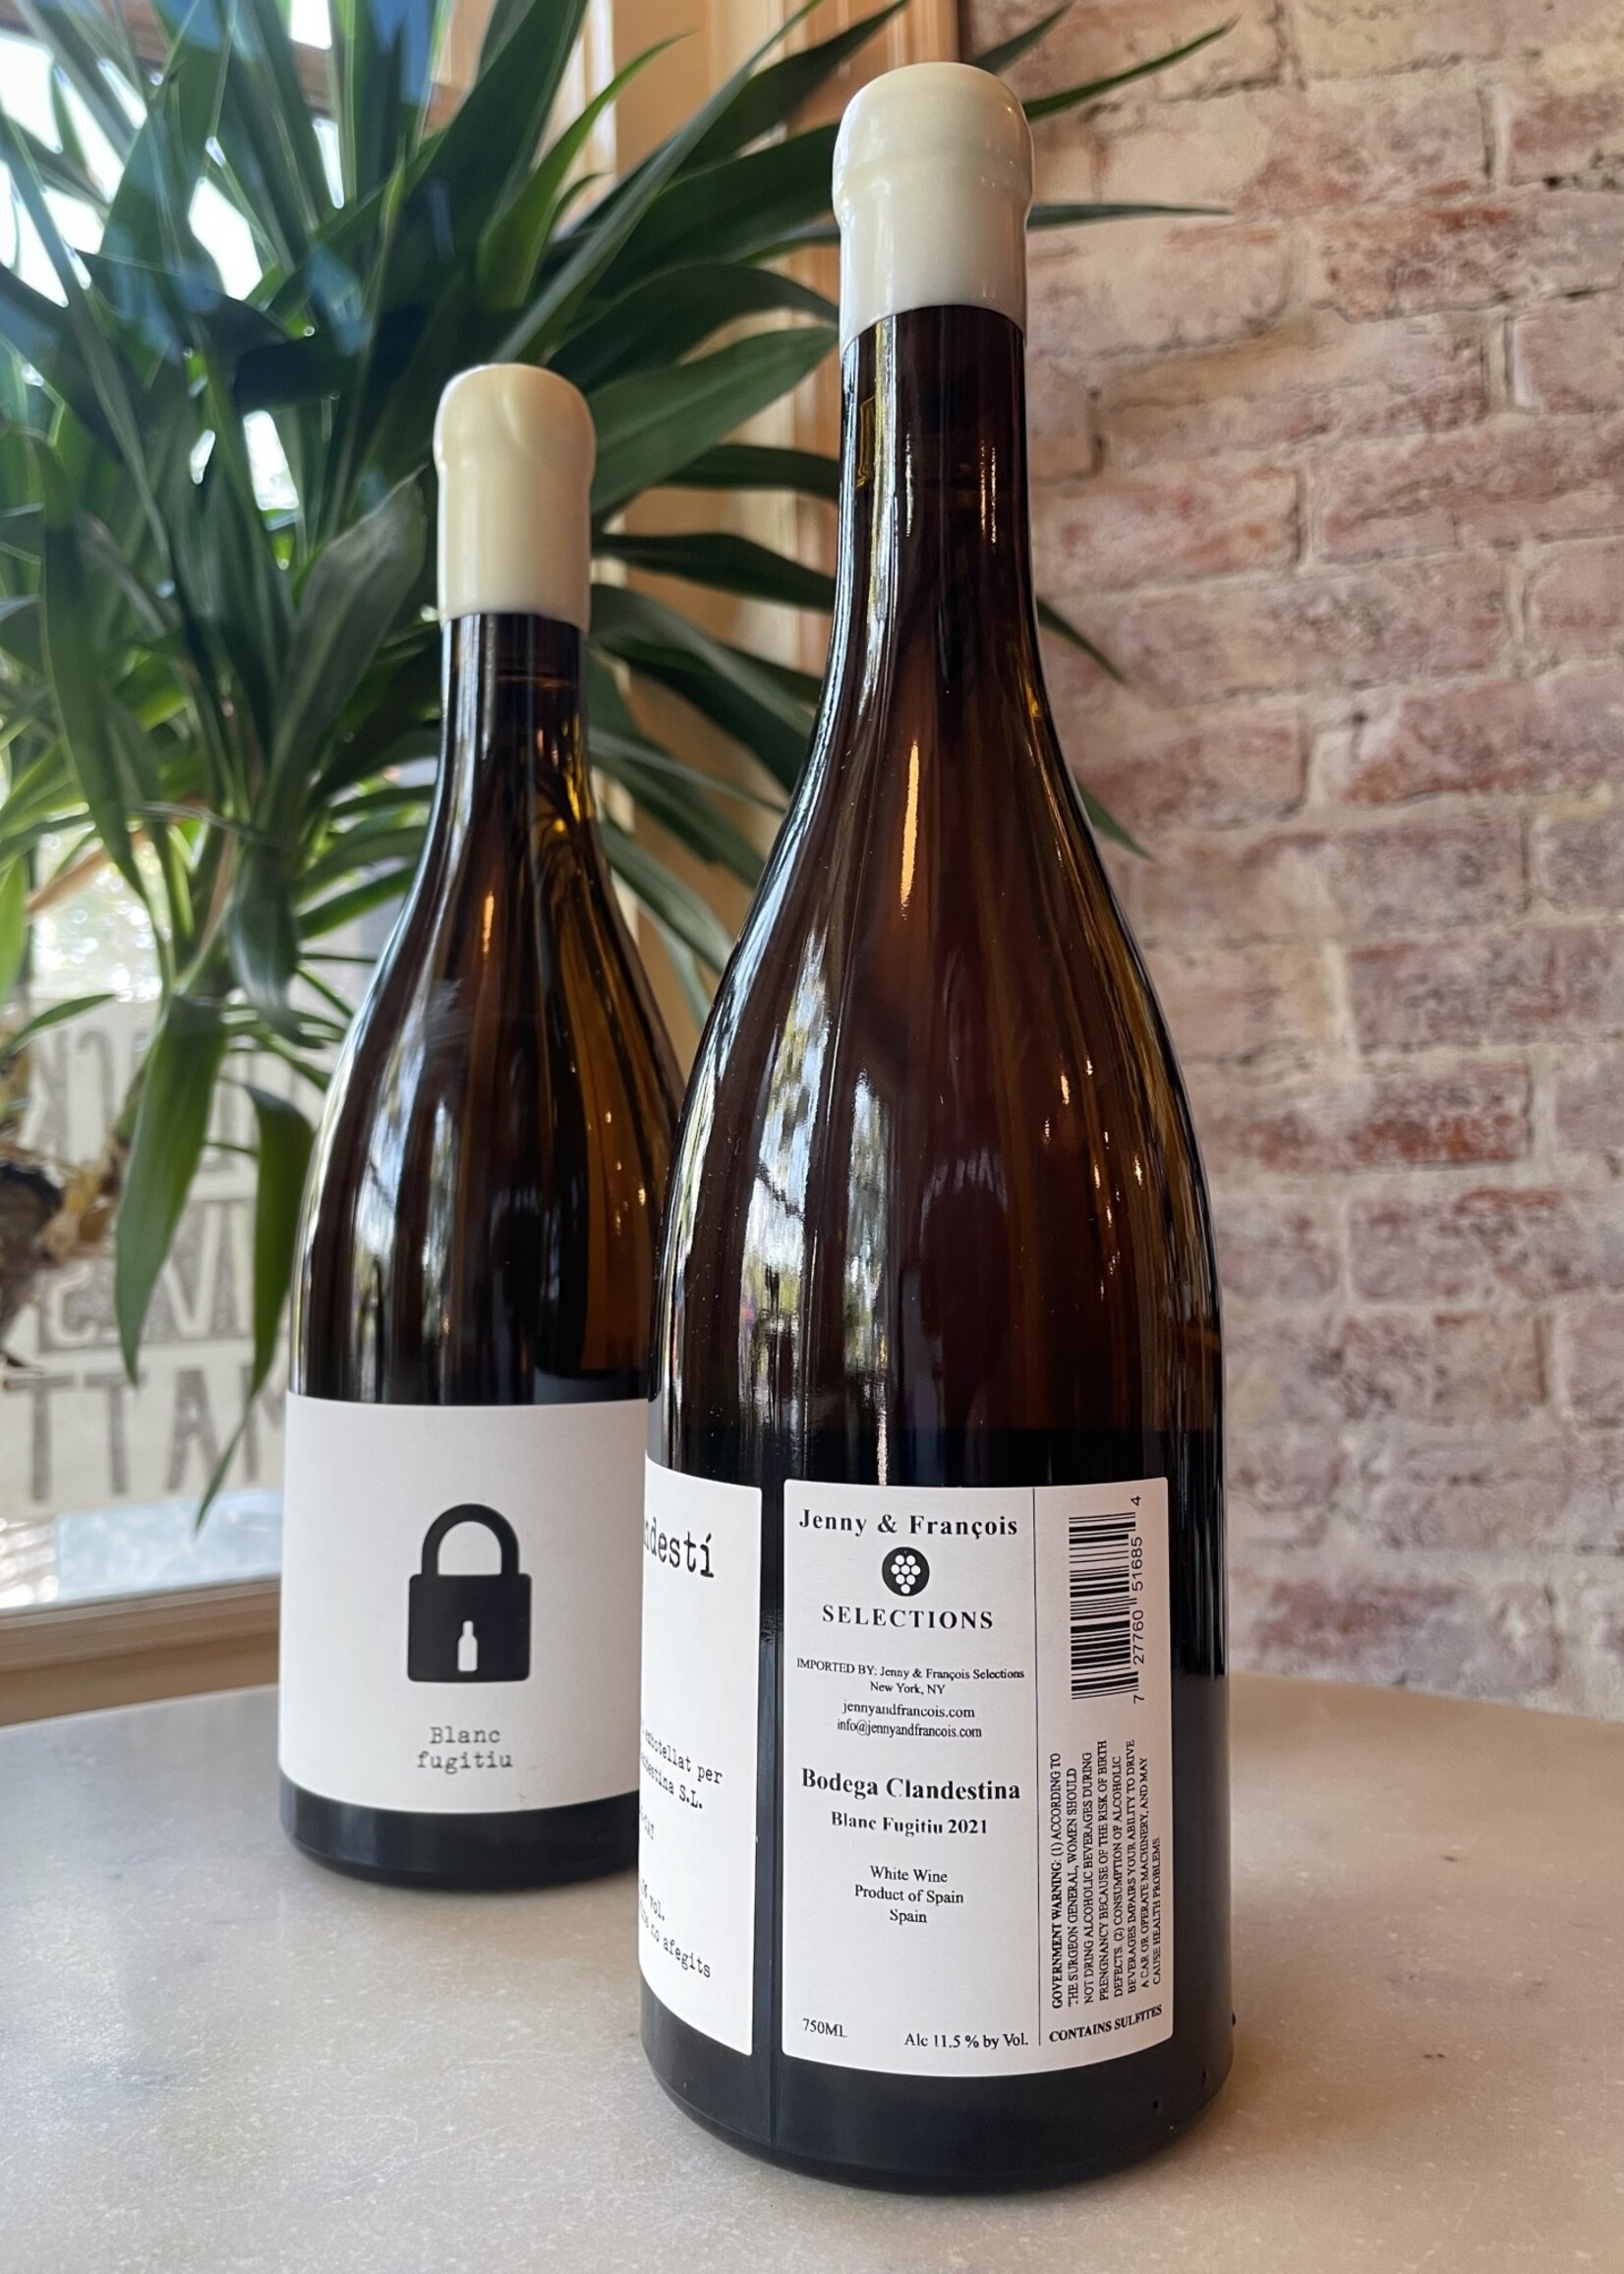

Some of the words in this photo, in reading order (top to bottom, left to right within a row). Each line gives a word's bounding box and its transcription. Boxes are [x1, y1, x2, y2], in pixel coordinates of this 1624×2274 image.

[1131, 1494, 1141, 1506] 4
[799, 1509, 867, 1537] Jenny
[877, 1514, 898, 1534] &
[909, 1515, 1017, 1540] François
[1131, 1536, 1143, 1591] 51685
[822, 1604, 993, 1630] SELECTIONS
[1132, 1610, 1144, 1664] 27760
[796, 1658, 855, 1674] IMPORTED
[858, 1663, 877, 1677] BY:
[880, 1666, 910, 1680] Jenny
[912, 1668, 922, 1679] &
[926, 1669, 970, 1681] François
[973, 1669, 1024, 1680] Selections
[870, 1681, 893, 1693] New
[896, 1683, 924, 1695] York,
[926, 1684, 946, 1695] NY
[1132, 1695, 1144, 1704] 7
[842, 1701, 975, 1720] jennyandfrancois.com
[430, 1726, 501, 1744] Blanc
[837, 1720, 982, 1738] info@jennyandfrancois.com
[417, 1750, 513, 1775] fugitiu
[1050, 1753, 1062, 1769] TO
[1097, 1740, 1107, 1776] BIRTH
[1139, 1757, 1148, 1783] MAY
[697, 1765, 723, 1784] per
[801, 1768, 878, 1800] Bodega
[886, 1778, 1020, 1800] Clandestina
[1082, 1752, 1092, 1799] DURING
[1098, 1778, 1107, 1793] OF
[1127, 1778, 1134, 1794] TO
[678, 1783, 703, 1809] S.L.
[1066, 1768, 1077, 1817] SHOULD
[1113, 1756, 1123, 1823] ALCOHOLIC
[1050, 1771, 1062, 1840] ACCORDING
[1098, 1793, 1108, 1822] RISK
[1127, 1796, 1135, 1840] ABILITY
[832, 1811, 876, 1831] Blanc
[883, 1817, 943, 1837] Fugitiu
[948, 1819, 988, 1835] 2021
[1083, 1800, 1093, 1870] BEVERAGES
[1099, 1823, 1109, 1848] THE
[1113, 1825, 1123, 1840] OF
[1051, 1842, 1064, 1857] (1)
[1067, 1819, 1077, 1864] WOMEN
[1140, 1810, 1149, 1882] MACHINERY,
[1099, 1850, 1109, 1864] OF
[1128, 1842, 1136, 1876] YOUR
[870, 1865, 908, 1882] White
[912, 1869, 948, 1884] Wine
[1113, 1842, 1123, 1925] CONSUMPTION
[854, 1885, 904, 1901] Product
[908, 1890, 924, 1901] of
[926, 1892, 963, 1906] Spain
[1051, 1859, 1062, 1921] WARNING:
[1068, 1864, 1079, 1923] GENERAL,
[1099, 1866, 1109, 1921] BECAUSE
[1128, 1878, 1136, 1923] IMPAIRS
[890, 1909, 928, 1925] Spain
[1083, 1872, 1093, 1938] ALCOHOLIC
[1140, 1883, 1149, 1935] OPERATE
[1114, 1927, 1125, 1941] (2)
[1140, 1936, 1149, 1953] OR
[663, 1937, 711, 1979] afegits
[1052, 1923, 1063, 2009] GOVERNMENT
[1068, 1927, 1078, 1980] SURGEON
[1083, 1941, 1093, 1978] DRING
[1128, 1925, 1136, 1994] BEVERAGES
[1140, 1954, 1149, 1978] CAR
[1083, 1981, 1093, 2004] NOT
[802, 2018, 847, 2039] 750ML
[904, 2033, 928, 2047] Alc
[934, 2035, 961, 2049] 11.5
[965, 2035, 979, 2049] %
[983, 2034, 999, 2050] by
[1003, 2033, 1028, 2047] Vol.
[1049, 2020, 1113, 2043] CONTAINS
